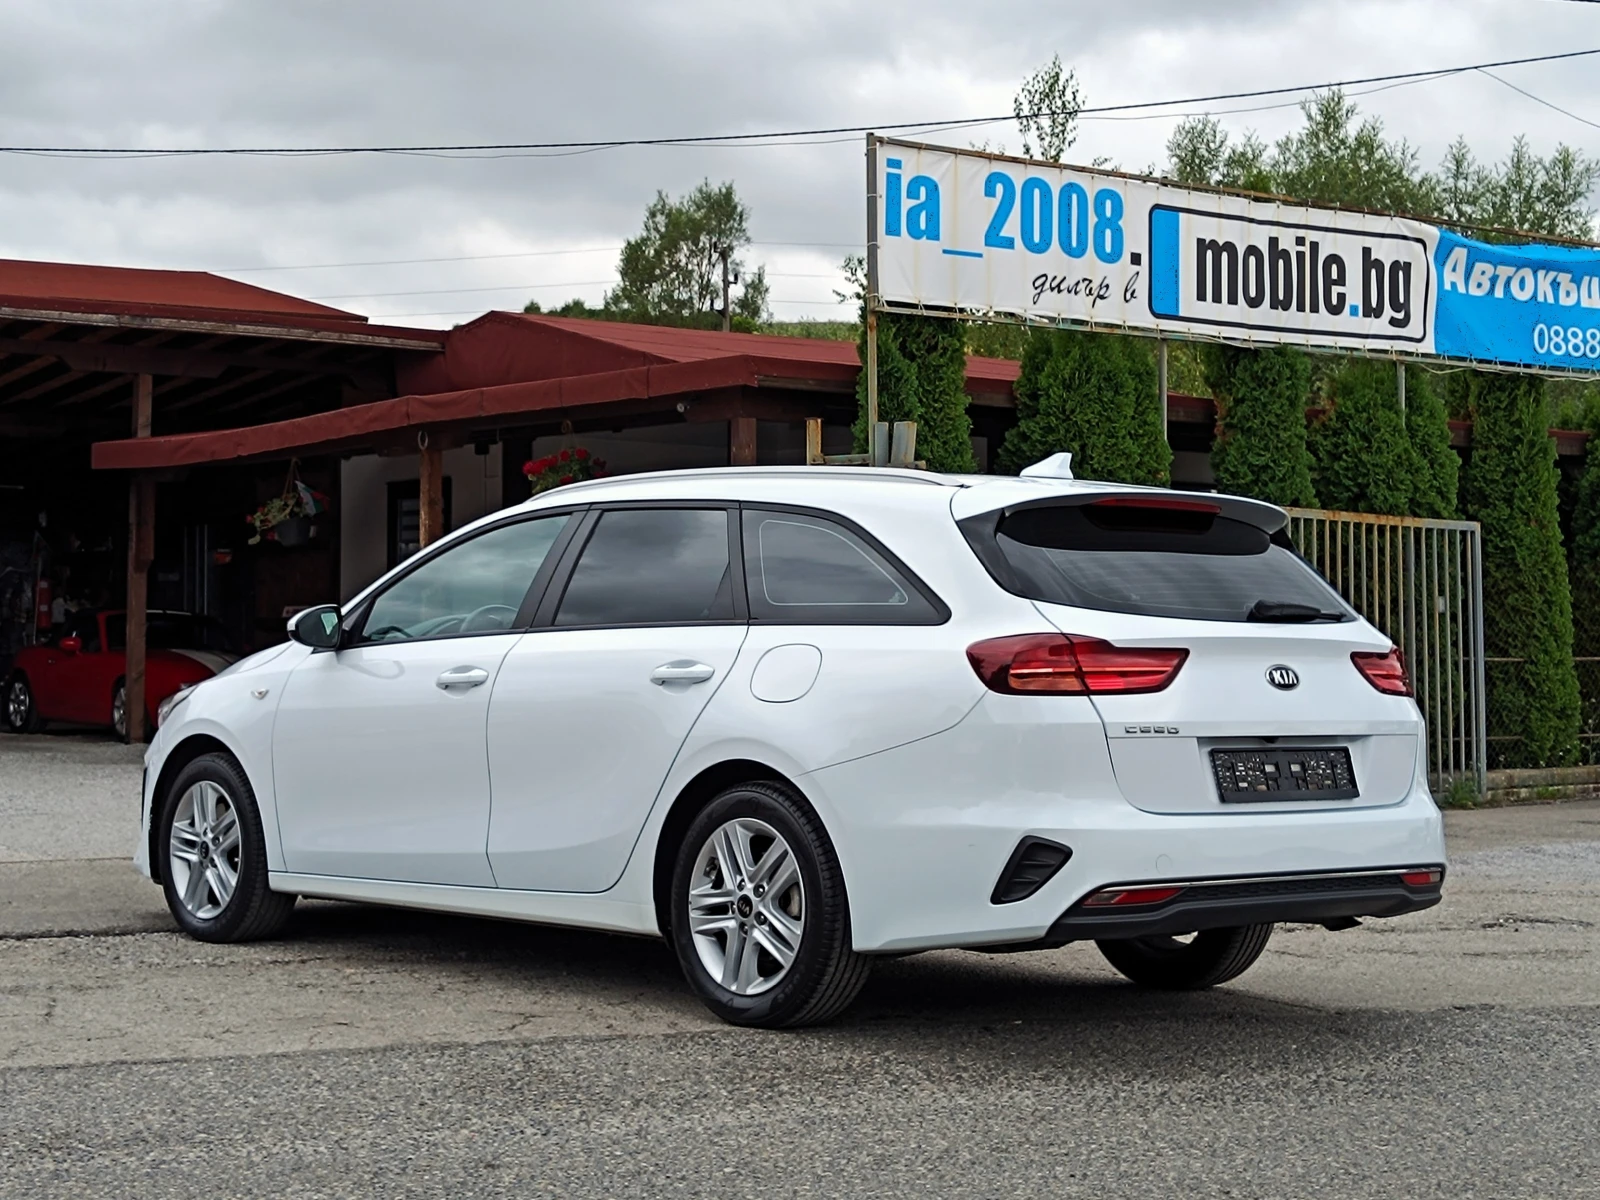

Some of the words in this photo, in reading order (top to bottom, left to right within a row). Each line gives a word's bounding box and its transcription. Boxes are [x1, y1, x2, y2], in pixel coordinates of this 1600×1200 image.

[1032, 273, 1111, 308] дилър
[1123, 271, 1140, 303] в
[1196, 236, 1412, 329] mobile.bg
[1533, 323, 1600, 359] 0888
[1271, 669, 1298, 685] KIA
